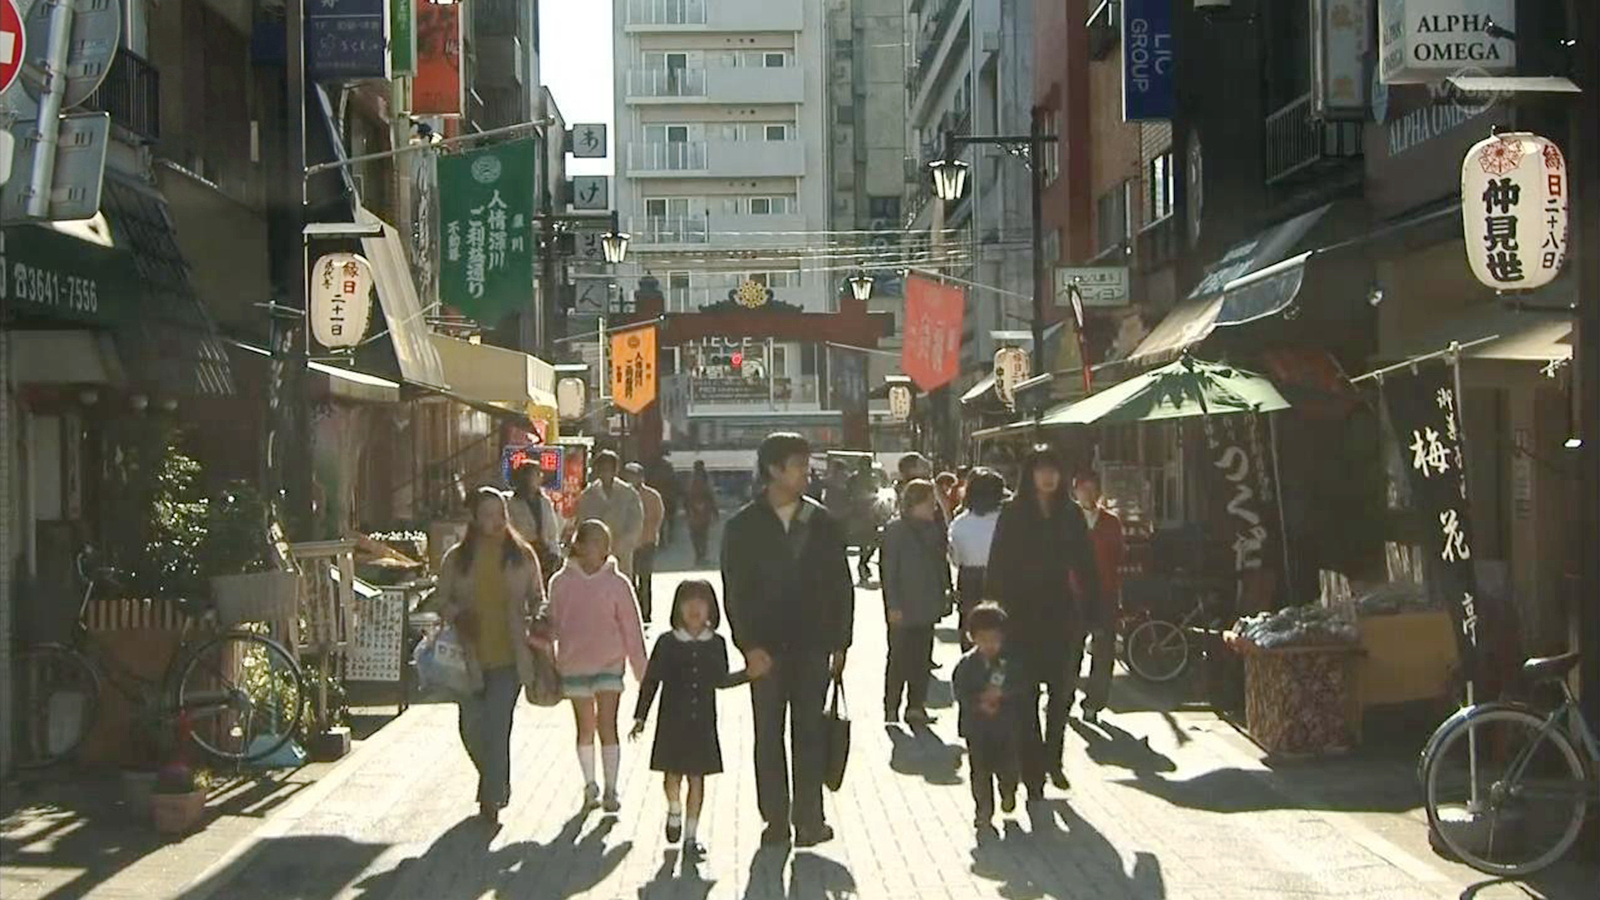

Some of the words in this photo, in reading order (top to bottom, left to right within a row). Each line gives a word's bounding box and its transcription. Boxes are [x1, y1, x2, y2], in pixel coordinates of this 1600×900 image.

[1417, 14, 1494, 33] ALPHA
[1131, 18, 1149, 92] GROUP
[1414, 43, 1501, 61] OMEGA
[1389, 106, 1430, 157] ALPHA
[1482, 177, 1525, 282] 仲見世
[28, 266, 97, 313] 3641-7556
[329, 294, 346, 336] 二十一日
[1213, 445, 1267, 571] つくだ
[1409, 426, 1478, 647] 梅花亭
